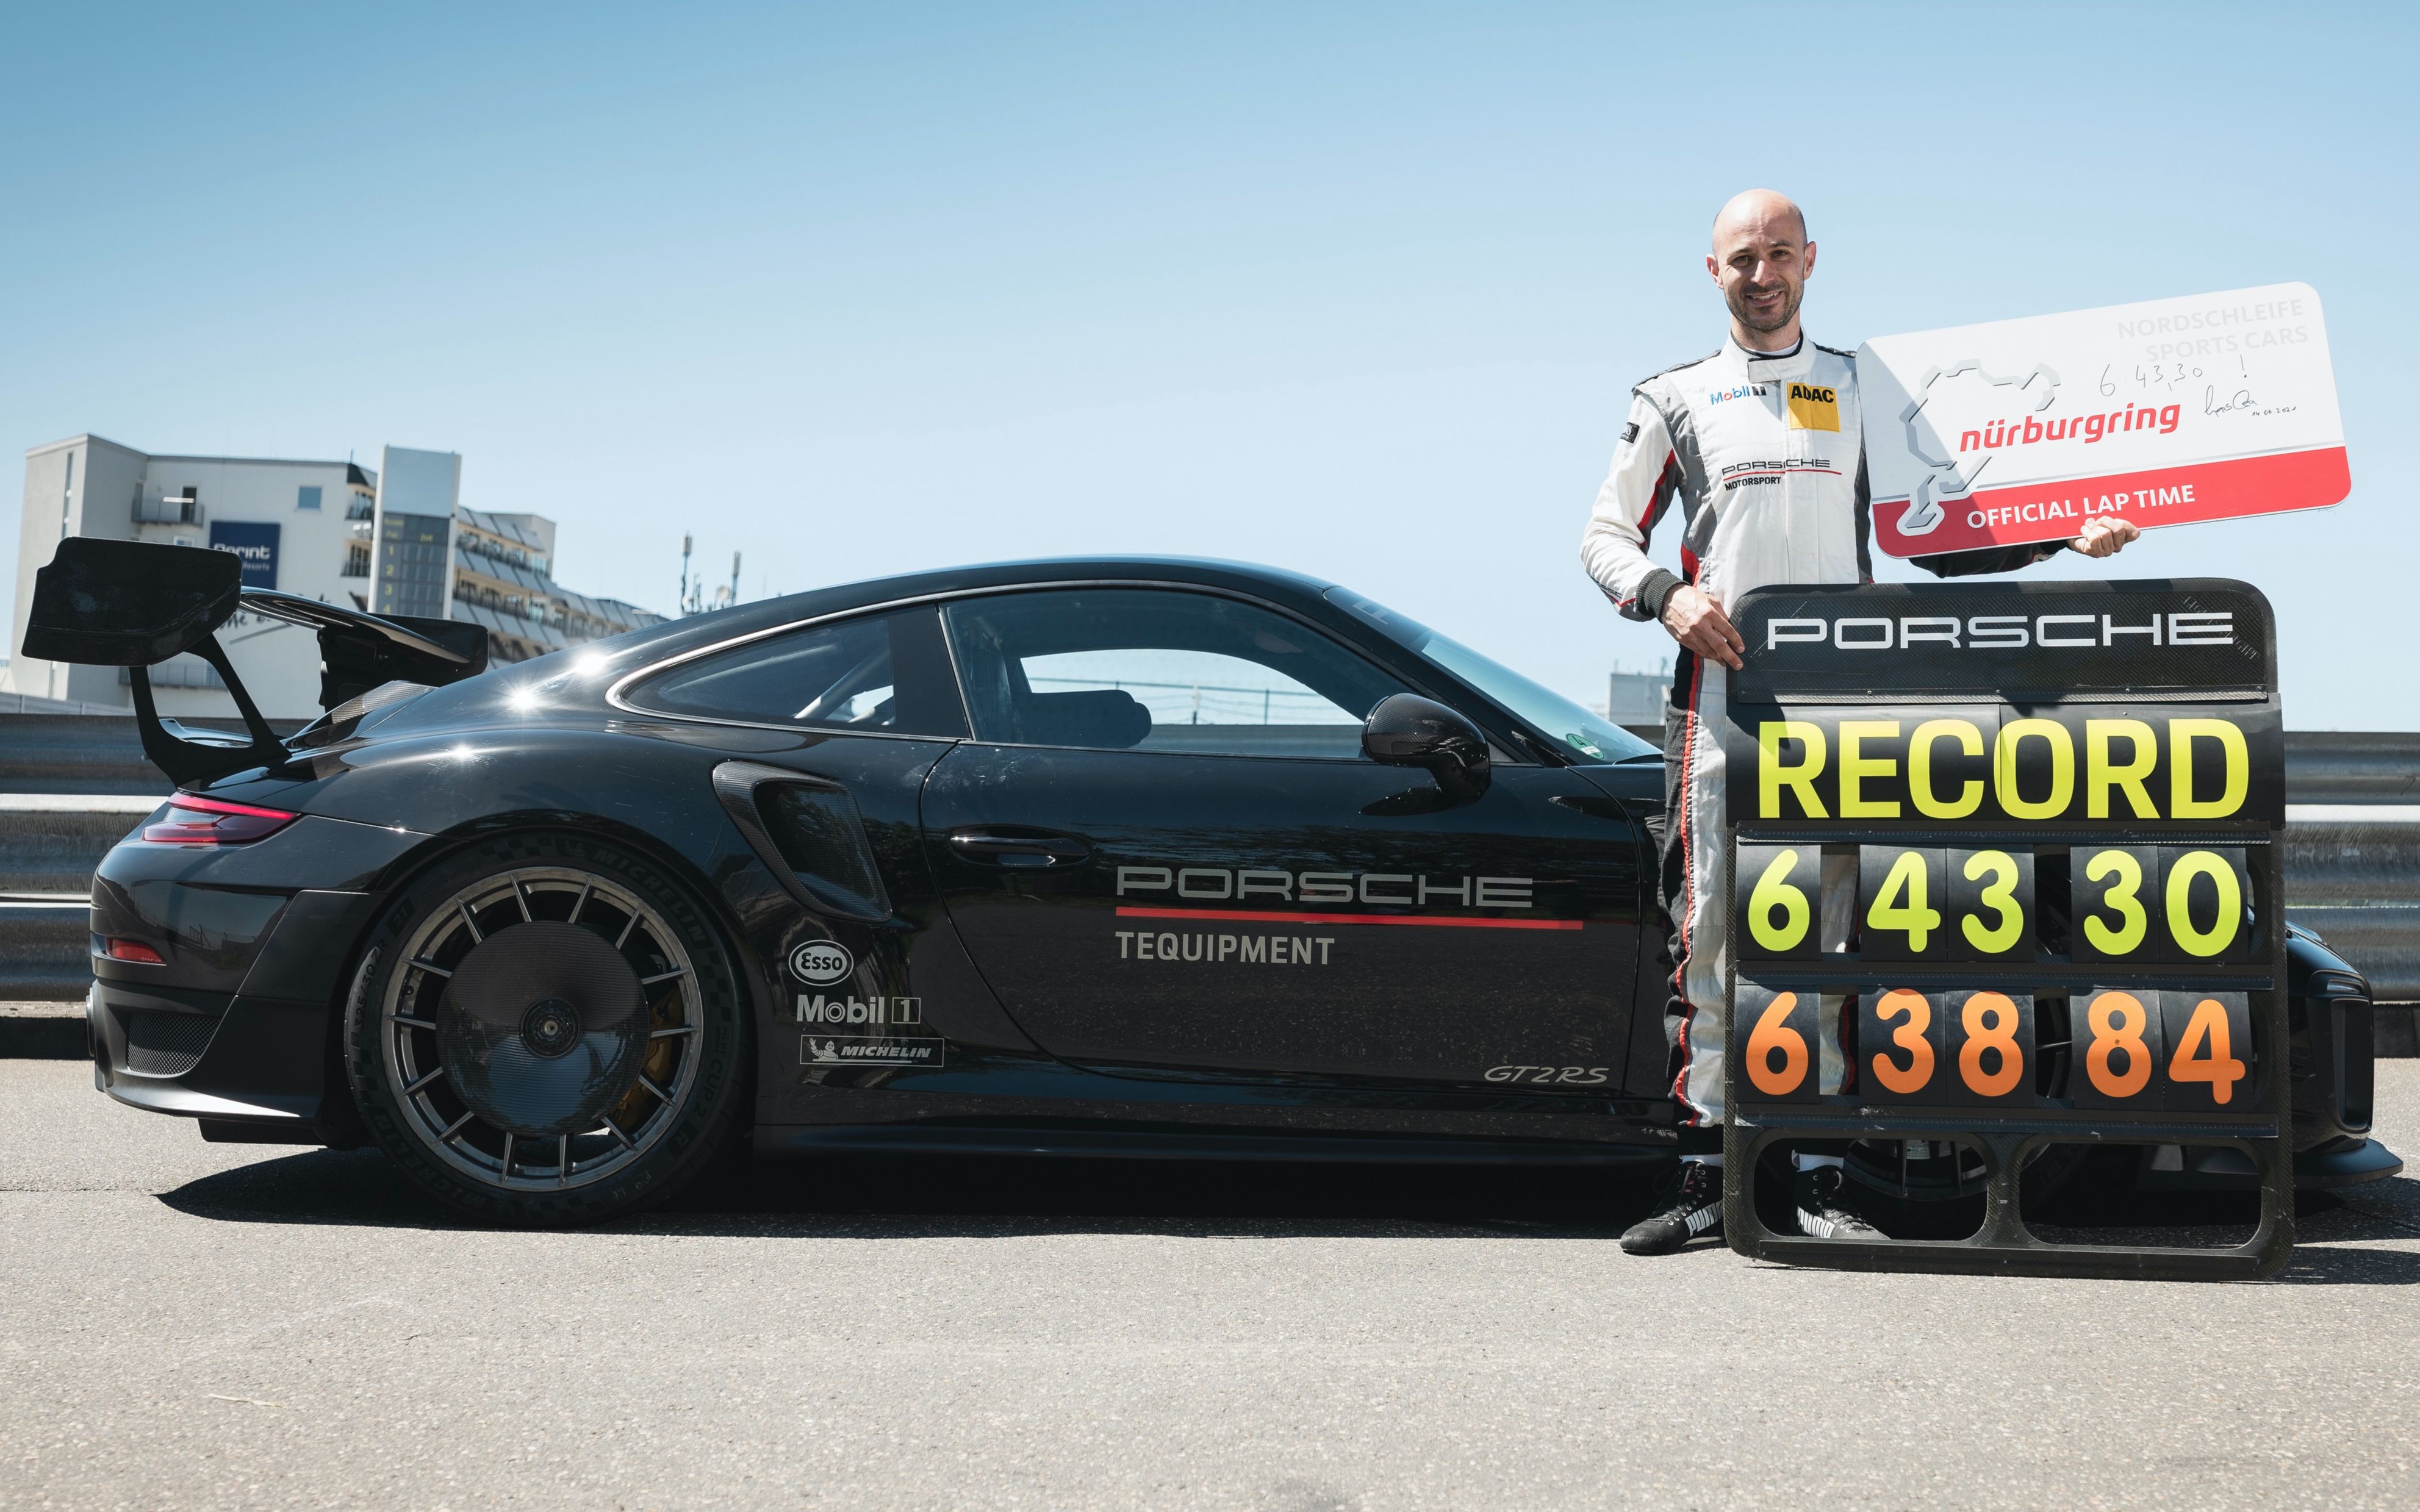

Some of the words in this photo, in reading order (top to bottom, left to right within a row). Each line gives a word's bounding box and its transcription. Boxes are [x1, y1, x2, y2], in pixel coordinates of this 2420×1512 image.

[2117, 299, 2304, 339] NORDSCHLEIFE
[2145, 335, 2239, 362] SPORTS
[2244, 325, 2308, 349] CARS
[1710, 385, 1750, 405] Mobil
[1791, 385, 1834, 403] ADAC
[1959, 403, 2180, 452] nürburgring
[1722, 459, 1830, 476] PORSCHE
[1725, 477, 1781, 491] MOTORSPORT
[1967, 499, 2078, 529] OFFICIAL
[2083, 493, 2130, 515] LAP
[2133, 484, 2196, 508] TIME
[386, 564, 394, 576] 2
[384, 583, 393, 596] 3
[1767, 612, 2233, 650] PORSCHE
[1759, 718, 2249, 820] RECORD
[592, 848, 709, 945] MICHELIN
[1116, 866, 1533, 908] PORSCHE
[1748, 849, 1810, 951] 6
[1867, 850, 2024, 953] 43
[2084, 850, 2241, 957] 30
[1115, 931, 1335, 966] TEQUIPMENT
[797, 994, 885, 1023] Mobil
[841, 1046, 932, 1058] MICHELIN
[1745, 991, 1809, 1096] 6
[1872, 989, 2023, 1097] 38
[2086, 991, 2246, 1105] 84
[1797, 1205, 1836, 1238] PUMA
